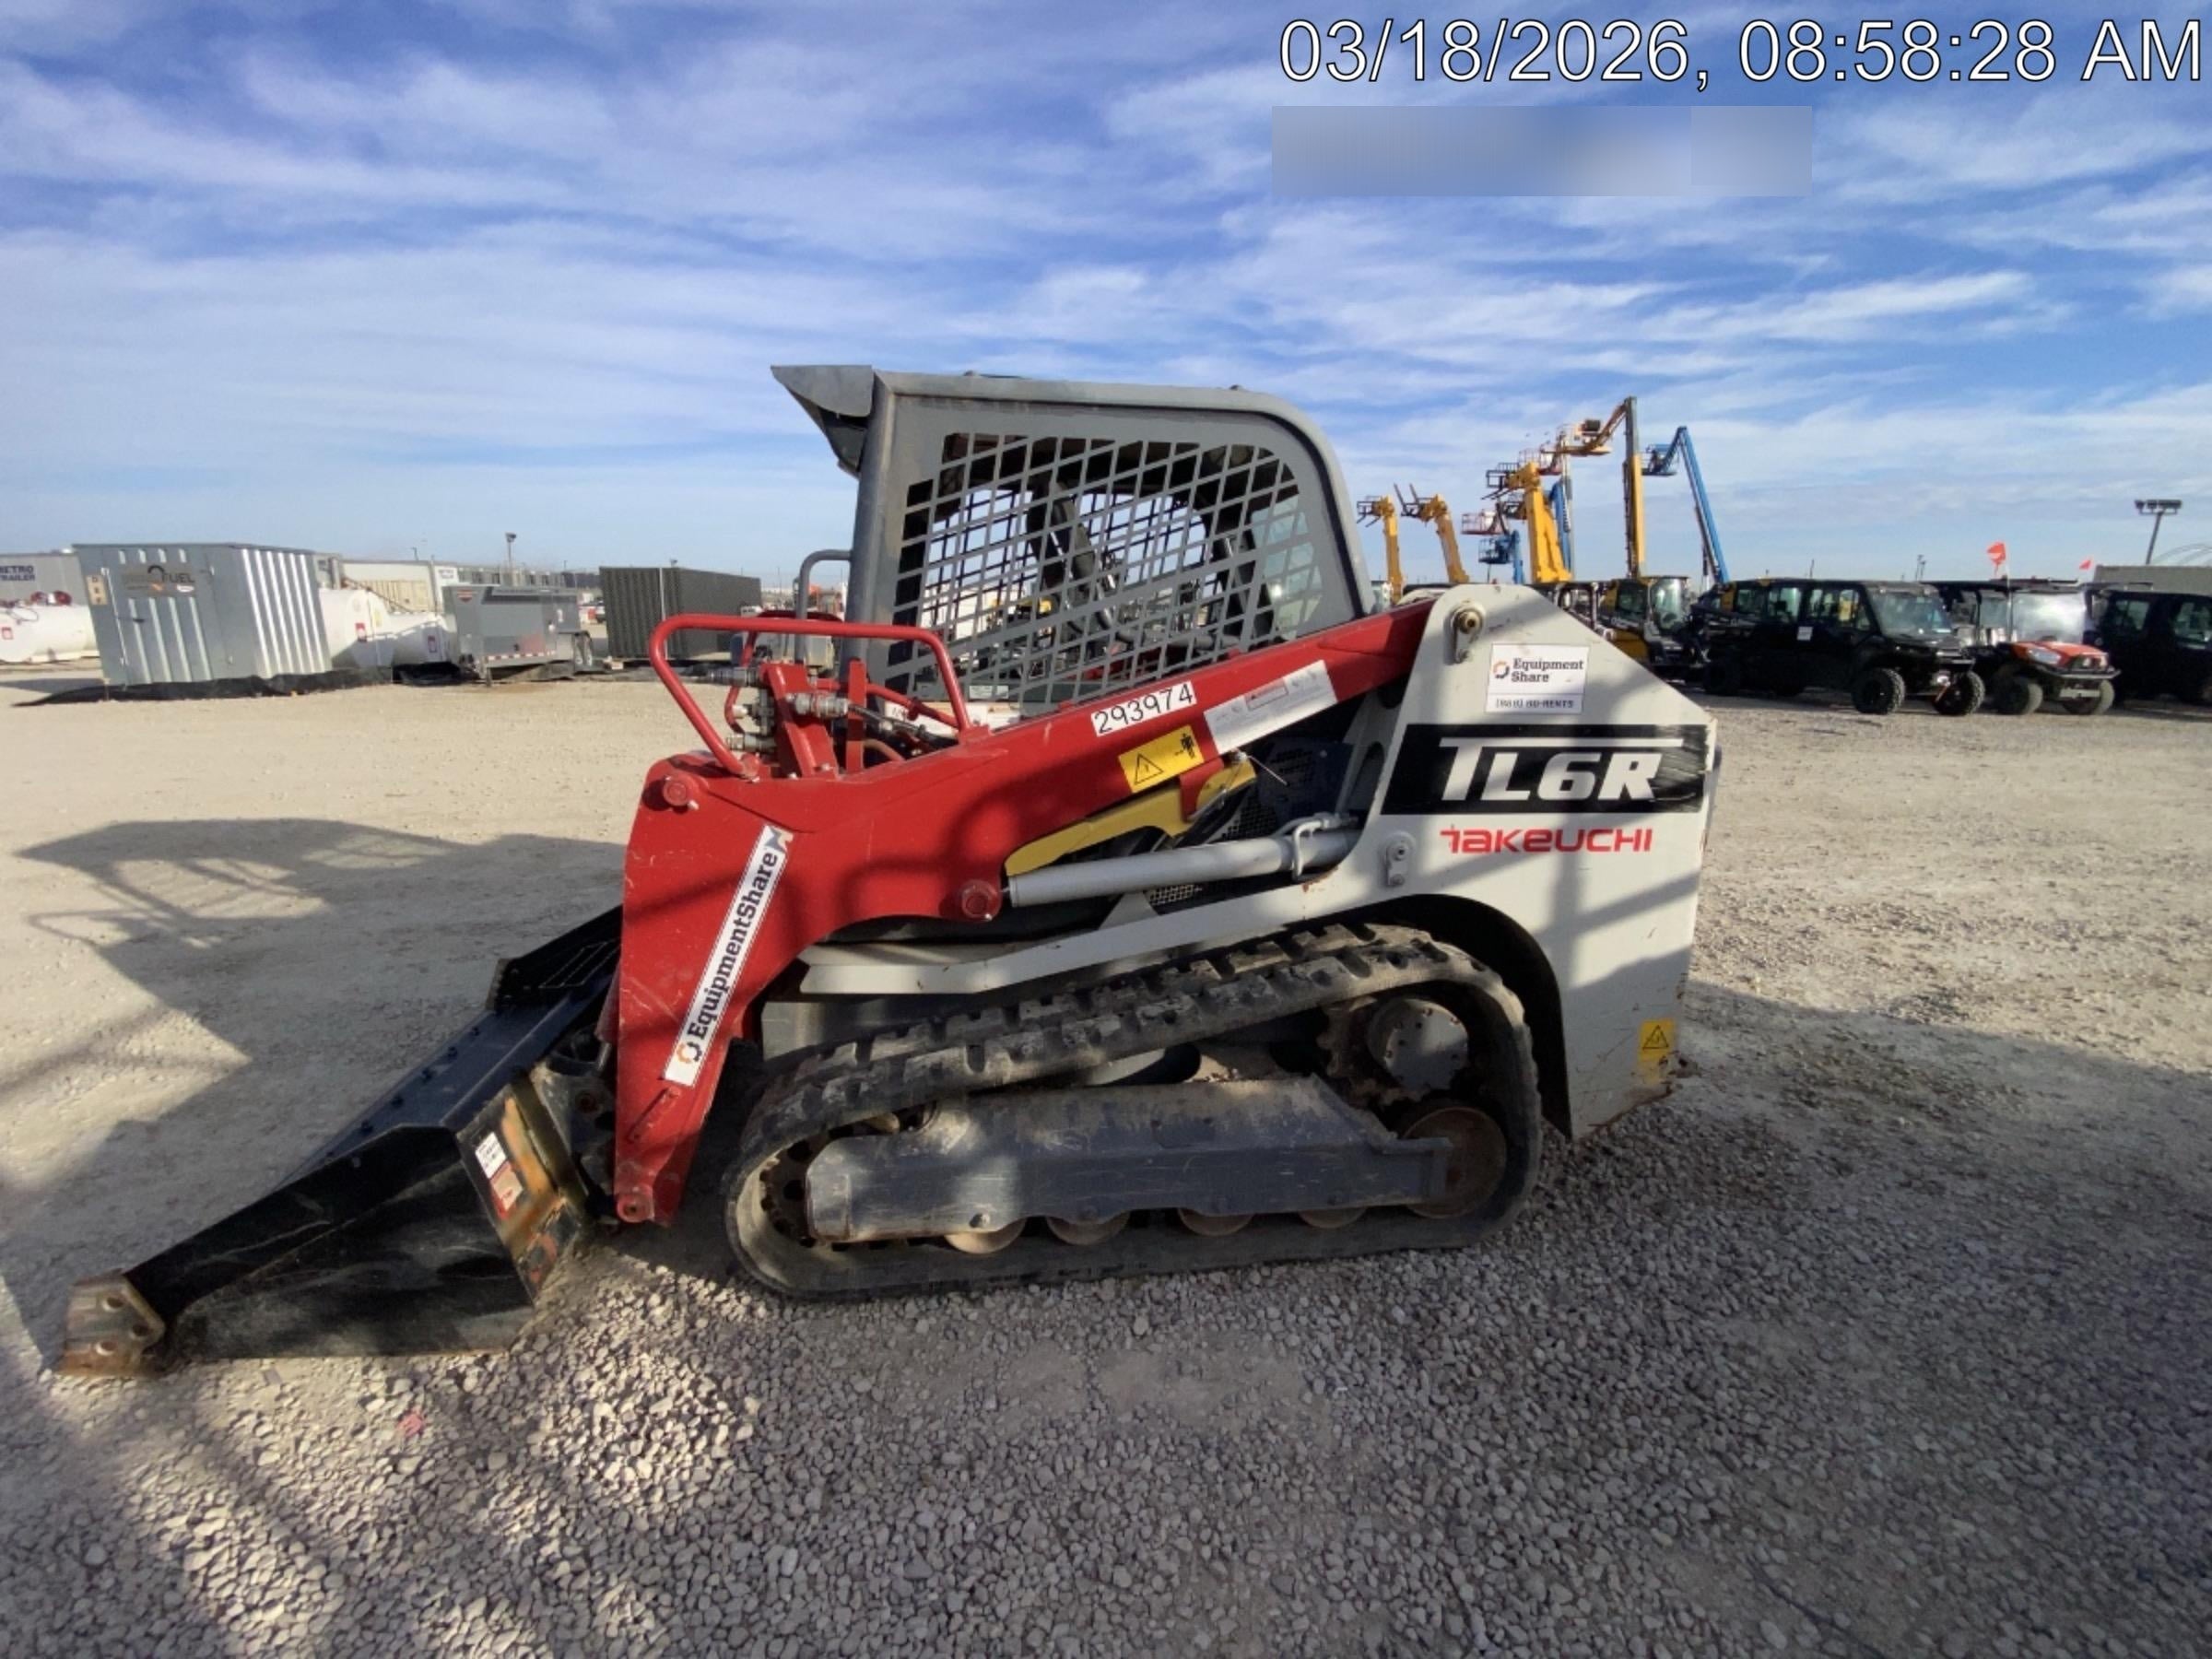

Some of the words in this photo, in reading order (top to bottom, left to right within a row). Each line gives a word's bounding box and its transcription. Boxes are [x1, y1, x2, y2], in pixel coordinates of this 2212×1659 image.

[162, 572, 195, 583] FUEL
[1511, 671, 1550, 684] Share
[1512, 658, 1584, 673] Equipment
[1094, 682, 1194, 735] 293974
[1440, 737, 1684, 802] TL6R
[687, 852, 778, 1041] EquipmentShare
